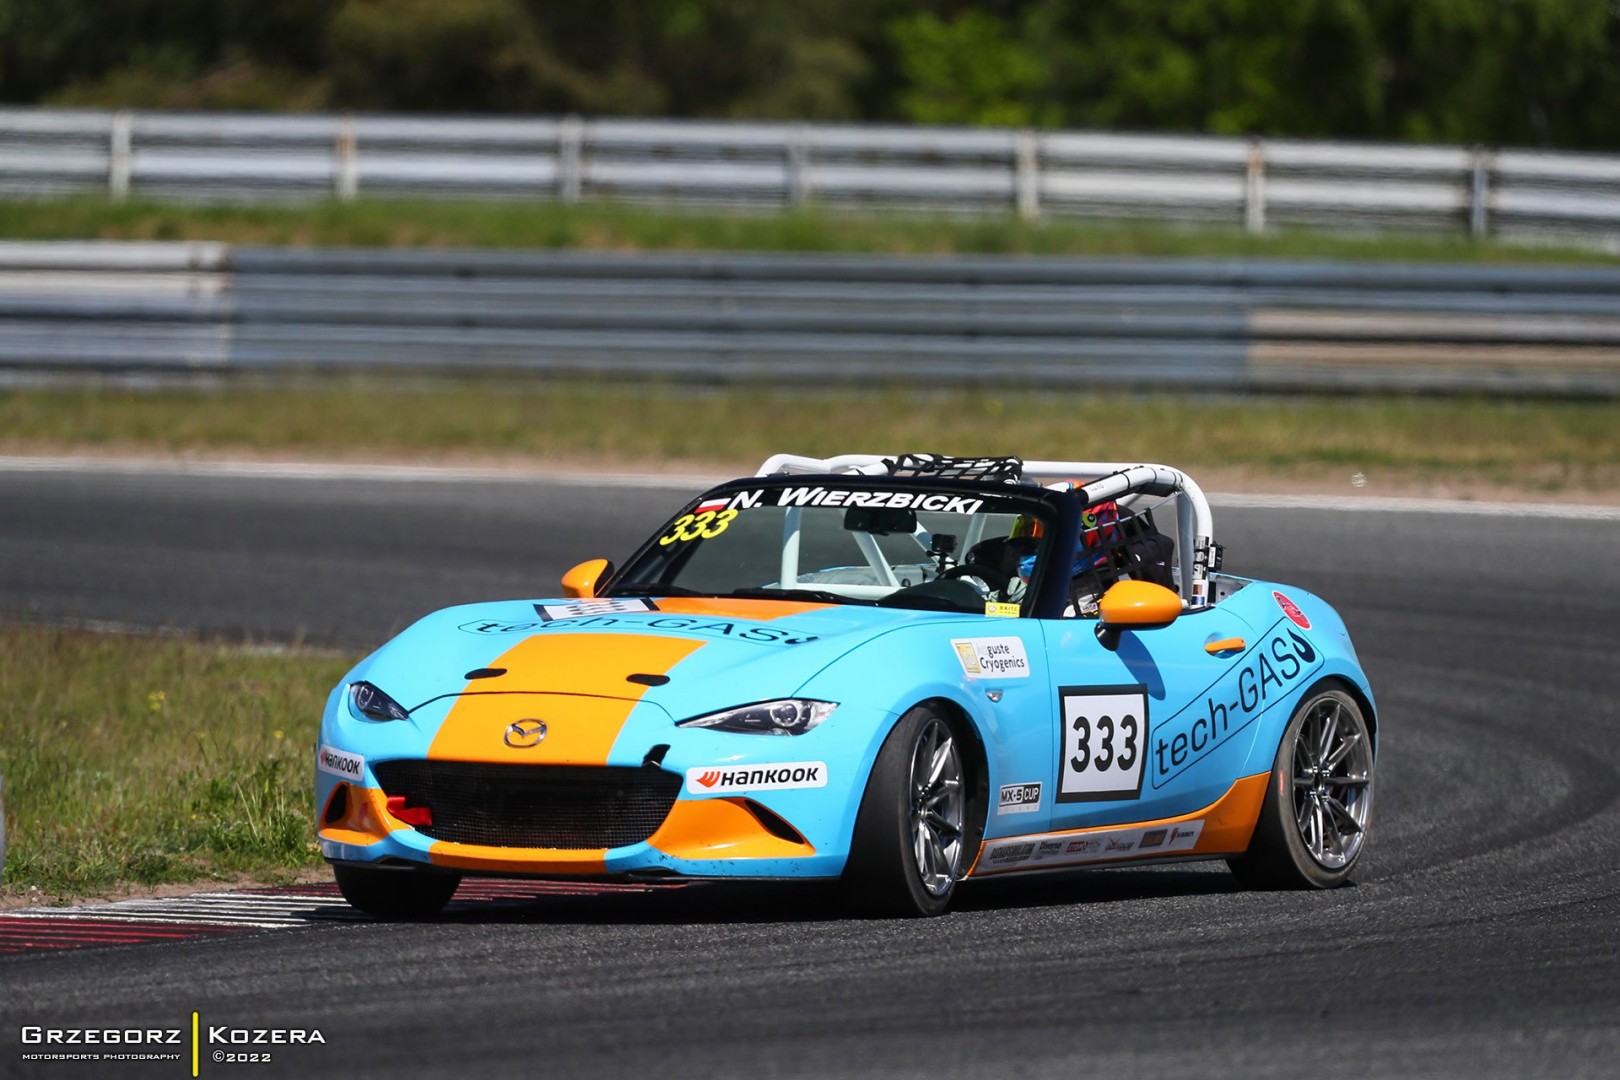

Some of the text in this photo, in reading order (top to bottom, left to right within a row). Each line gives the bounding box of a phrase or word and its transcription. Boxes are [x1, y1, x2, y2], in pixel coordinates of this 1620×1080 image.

[727, 486, 985, 515] N. WIERZBICKI
[659, 508, 739, 546] 333
[979, 655, 1025, 673] Cryogenics
[1155, 637, 1301, 776] tech-GAS
[1070, 712, 1139, 774] 333
[1024, 787, 1039, 801] CUP
